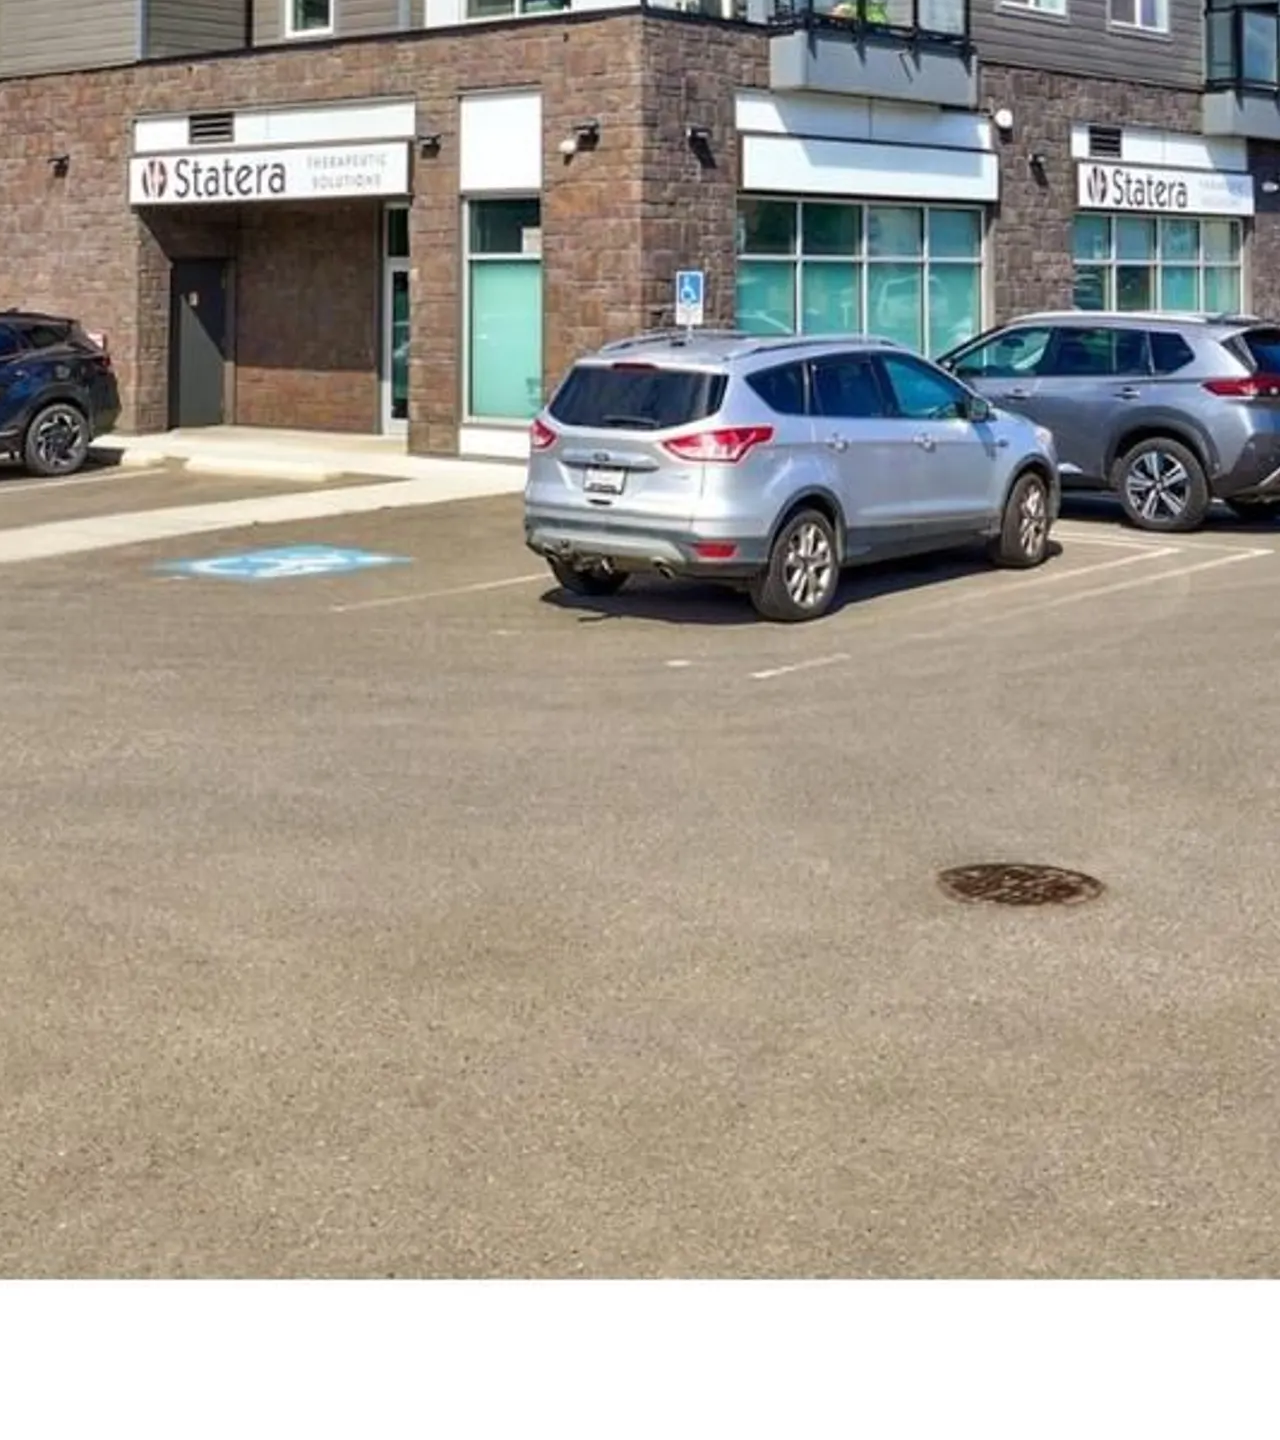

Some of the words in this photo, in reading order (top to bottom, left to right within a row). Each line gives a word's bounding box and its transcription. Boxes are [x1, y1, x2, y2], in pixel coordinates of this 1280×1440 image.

[306, 153, 388, 169] THERAPEUTIC
[173, 158, 287, 198] Statera
[311, 173, 382, 190] SOLUTIONS
[1112, 169, 1189, 209] Statera
